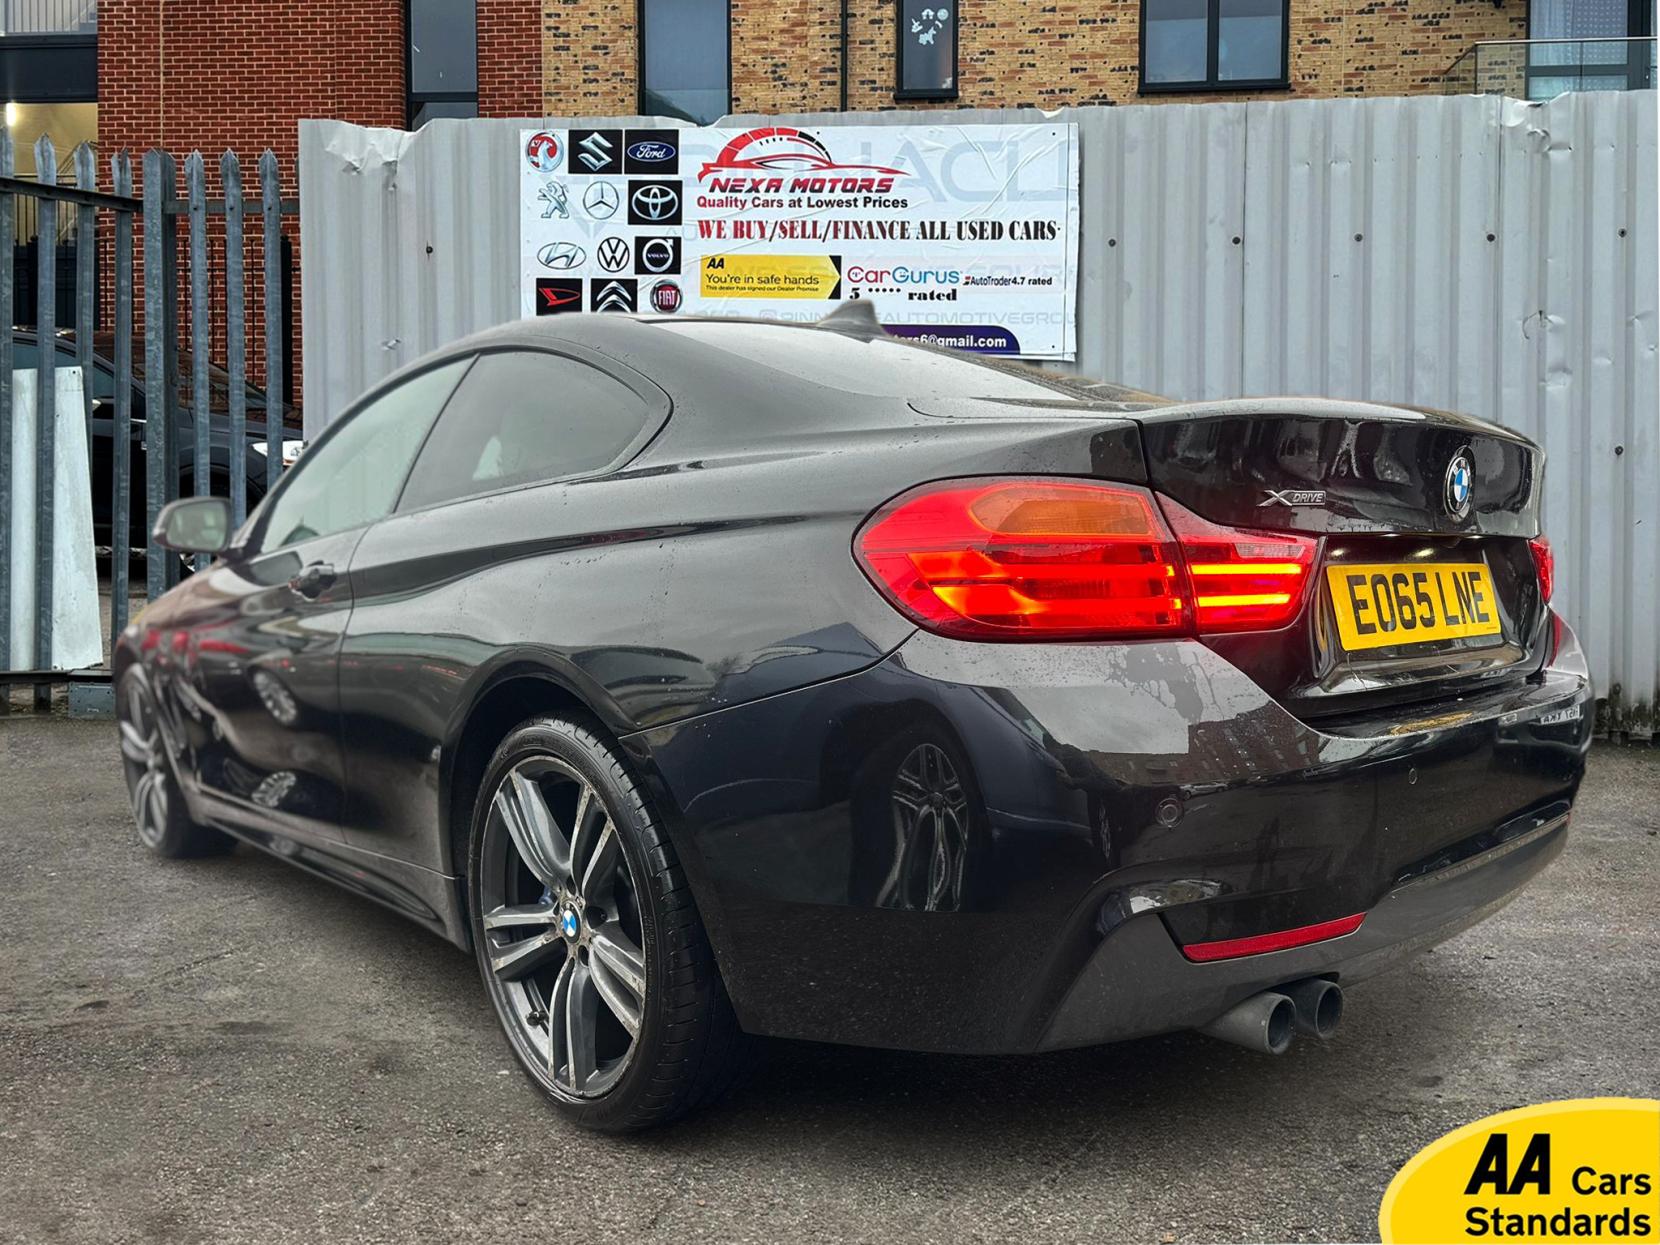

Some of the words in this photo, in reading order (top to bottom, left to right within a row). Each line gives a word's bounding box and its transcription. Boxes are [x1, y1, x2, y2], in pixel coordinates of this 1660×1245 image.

[636, 144, 666, 159] Ford
[709, 178, 783, 194] NEXA
[789, 178, 894, 194] MOTORS
[697, 196, 747, 210] Quality
[752, 196, 784, 208] Cars
[788, 196, 803, 208] at
[807, 196, 859, 208] Lowest
[863, 196, 908, 208] Prices
[697, 220, 727, 240] WE
[733, 220, 911, 242] BUY/SELL/FINANCE
[917, 220, 950, 241] ALL
[956, 220, 1004, 241] USED
[707, 257, 725, 269] AA
[706, 274, 741, 284] You're
[744, 274, 754, 284] in
[757, 274, 781, 284] safe
[784, 275, 820, 285] hands
[847, 266, 960, 284] CarGurus
[1011, 277, 1026, 285] 4.7
[1028, 277, 1053, 285] rated
[658, 290, 677, 305] FIAT
[849, 288, 860, 300] 5
[908, 288, 957, 301] rated
[1435, 571, 1490, 627] LNE
